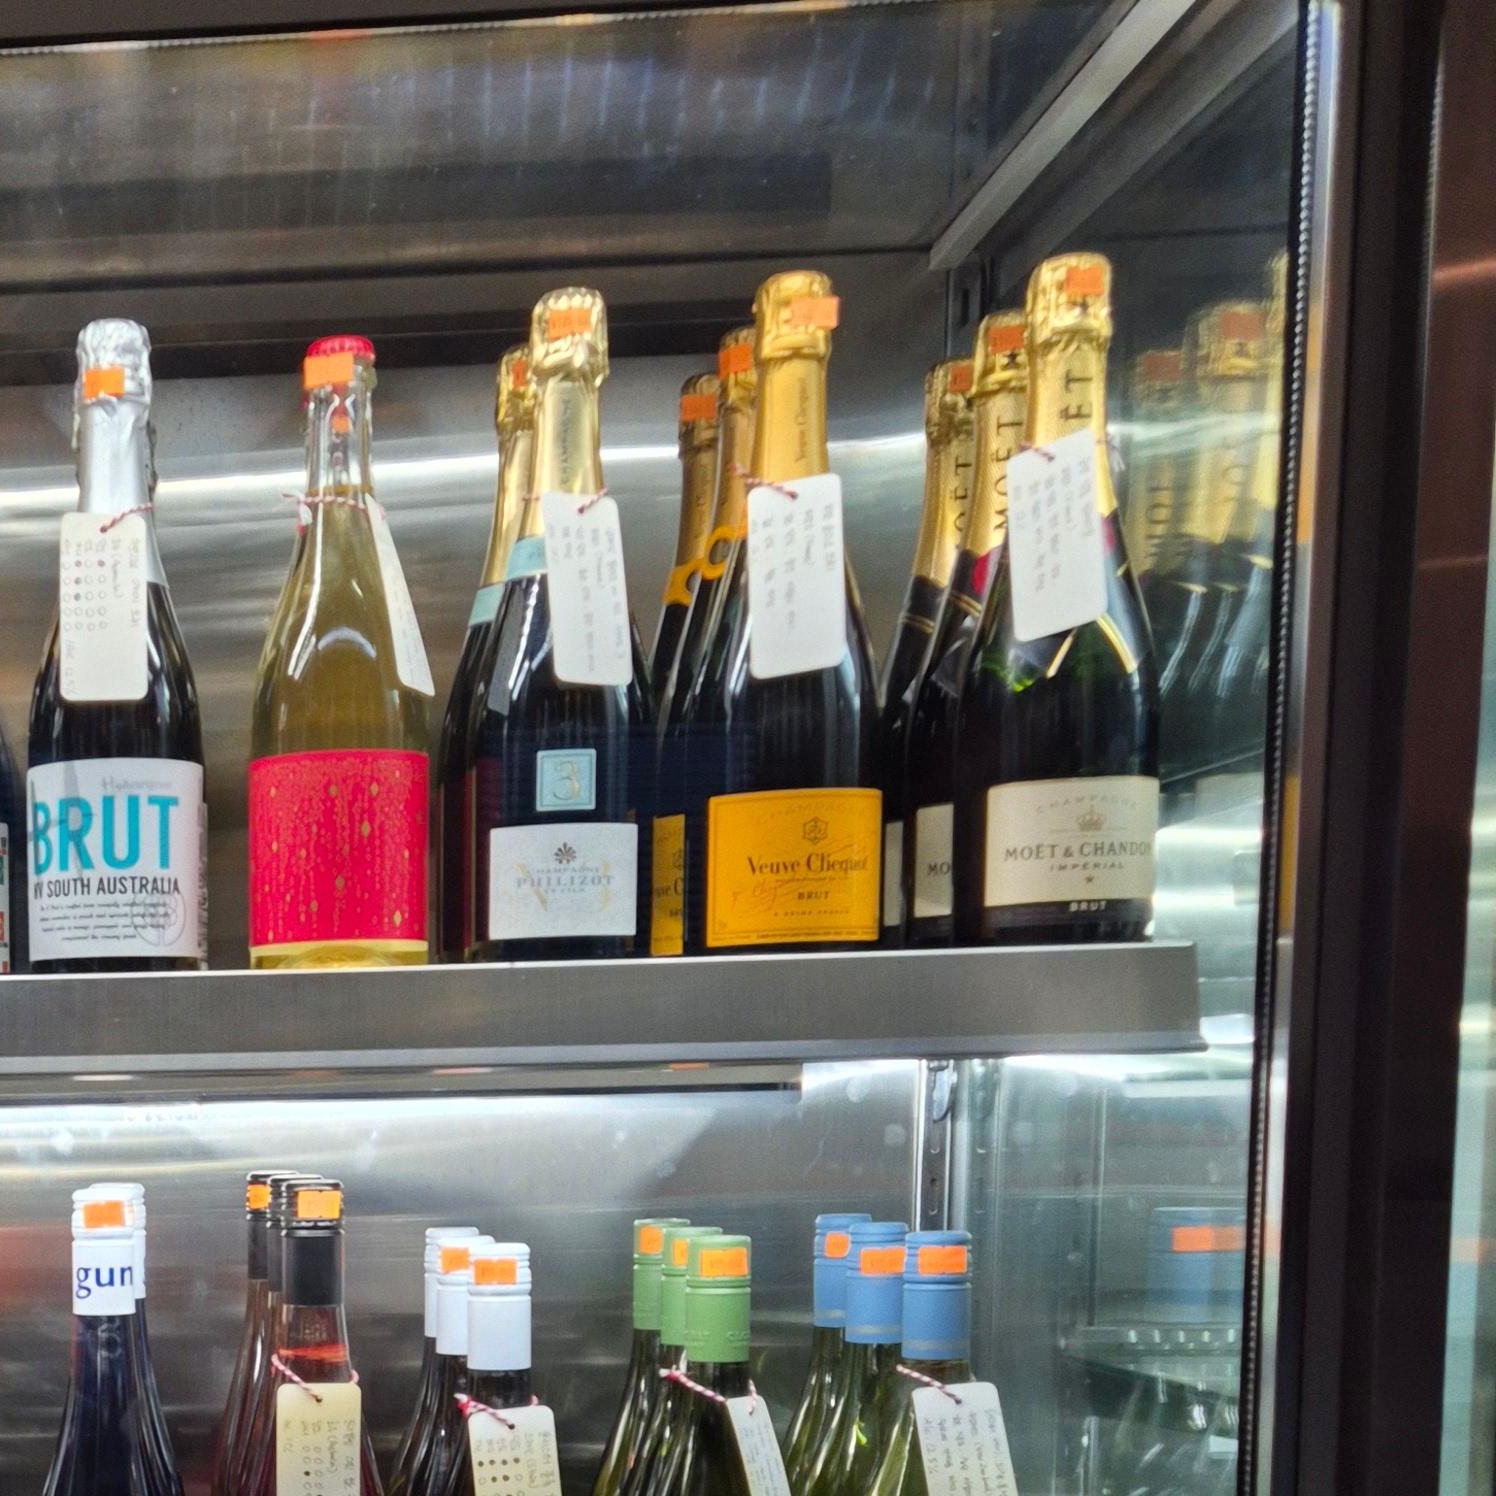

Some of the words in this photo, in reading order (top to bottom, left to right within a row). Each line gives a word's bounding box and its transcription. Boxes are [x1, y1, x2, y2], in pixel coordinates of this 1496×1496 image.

[553, 759, 581, 801] 3
[32, 793, 180, 877] BRUT
[1063, 846, 1075, 858] &
[1079, 840, 1153, 858] CHANDON
[747, 855, 801, 876] Veuve
[805, 851, 868, 875] Clicquot
[927, 861, 951, 876] MO
[47, 877, 92, 898] SOUTH
[96, 875, 182, 896] AUSTRALIA
[797, 890, 830, 901] BRUT
[1068, 901, 1108, 913] BRUT
